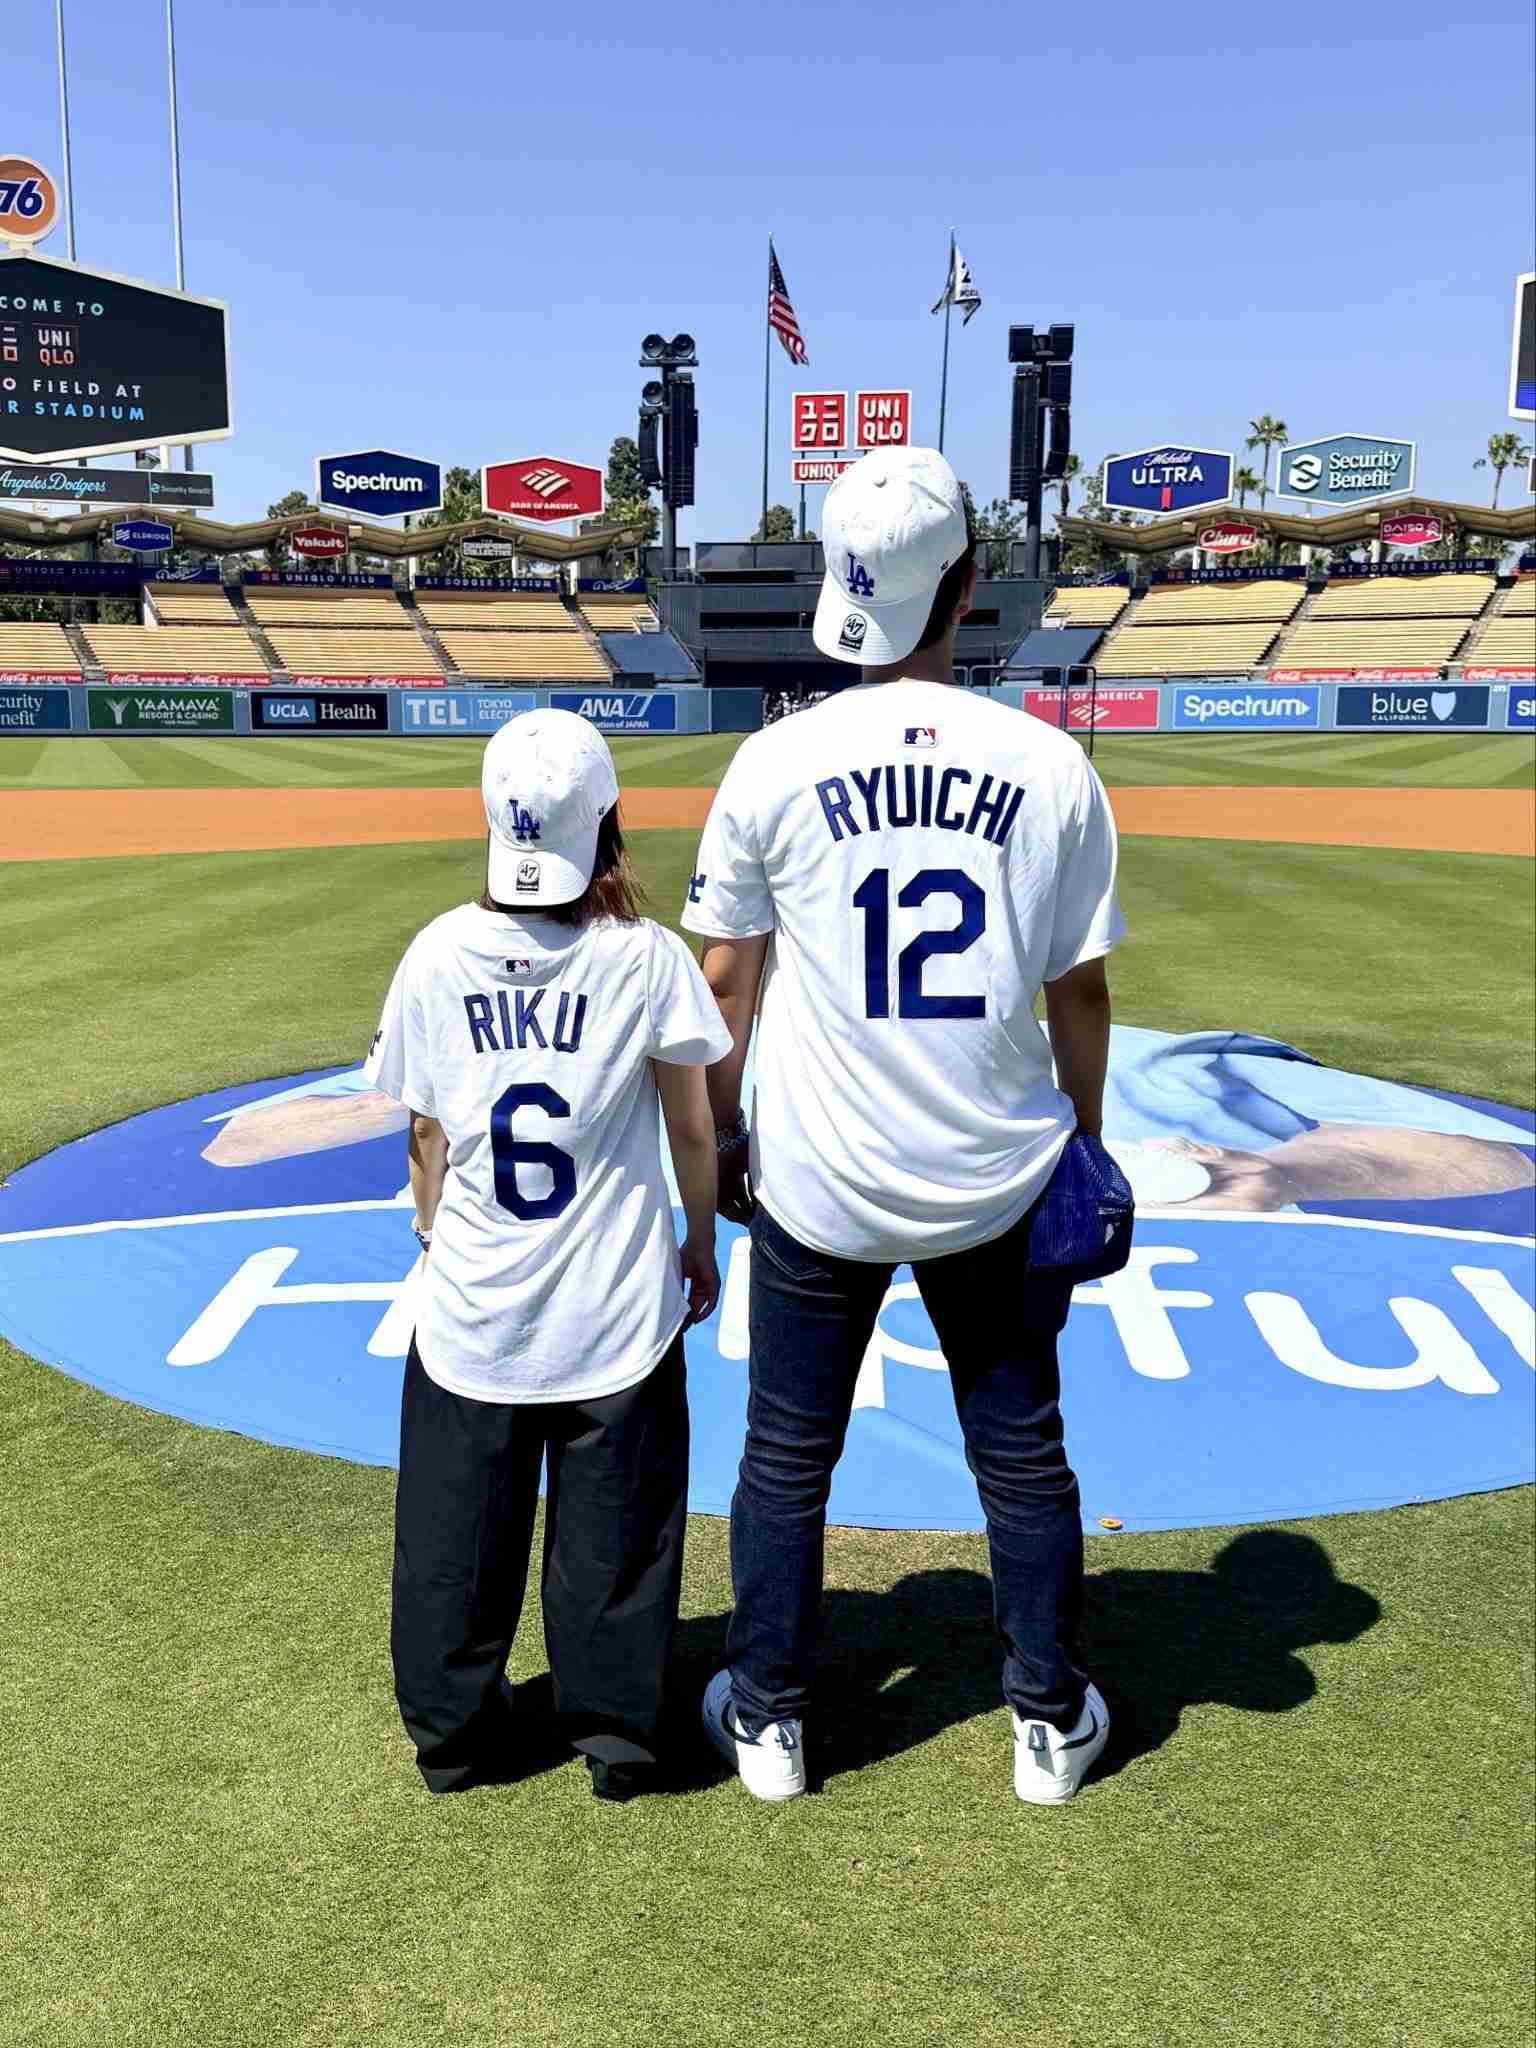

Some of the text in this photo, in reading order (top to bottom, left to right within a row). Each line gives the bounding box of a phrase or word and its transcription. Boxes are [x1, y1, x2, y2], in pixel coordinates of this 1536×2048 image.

[0, 178, 44, 218] 76
[76, 301, 104, 316] TO
[38, 329, 71, 347] UNI
[39, 348, 74, 366] QLO
[33, 379, 100, 395] FIELD
[115, 384, 142, 398] AT
[35, 401, 144, 421] STADIUM
[863, 399, 901, 419] UNI
[863, 421, 903, 444] QLO
[1328, 450, 1402, 470] Security
[332, 470, 423, 493] Spectrum
[799, 463, 848, 480] UNIQL
[1132, 465, 1204, 485] ULTRA
[1328, 471, 1393, 489] Benefit
[0, 470, 106, 498] Angeles Dodgers
[544, 502, 579, 511] AMERICA
[132, 533, 170, 542] ELDRIDGE
[1383, 523, 1424, 533] DAISO
[295, 537, 345, 549] Yakult
[286, 574, 335, 583] UNIQLO
[269, 702, 377, 720] UCLA Health
[406, 698, 467, 726] TEL
[478, 699, 513, 709] TOKYO
[577, 698, 625, 719] ANA
[1183, 695, 1302, 723] Spectrum
[1371, 692, 1429, 714] blue
[139, 712, 174, 720] RESORT
[184, 712, 219, 720] CASINO
[815, 764, 1026, 847] RYUICHI
[853, 868, 987, 1020] 12
[463, 988, 589, 1055] RIKU
[490, 1081, 578, 1222] 6
